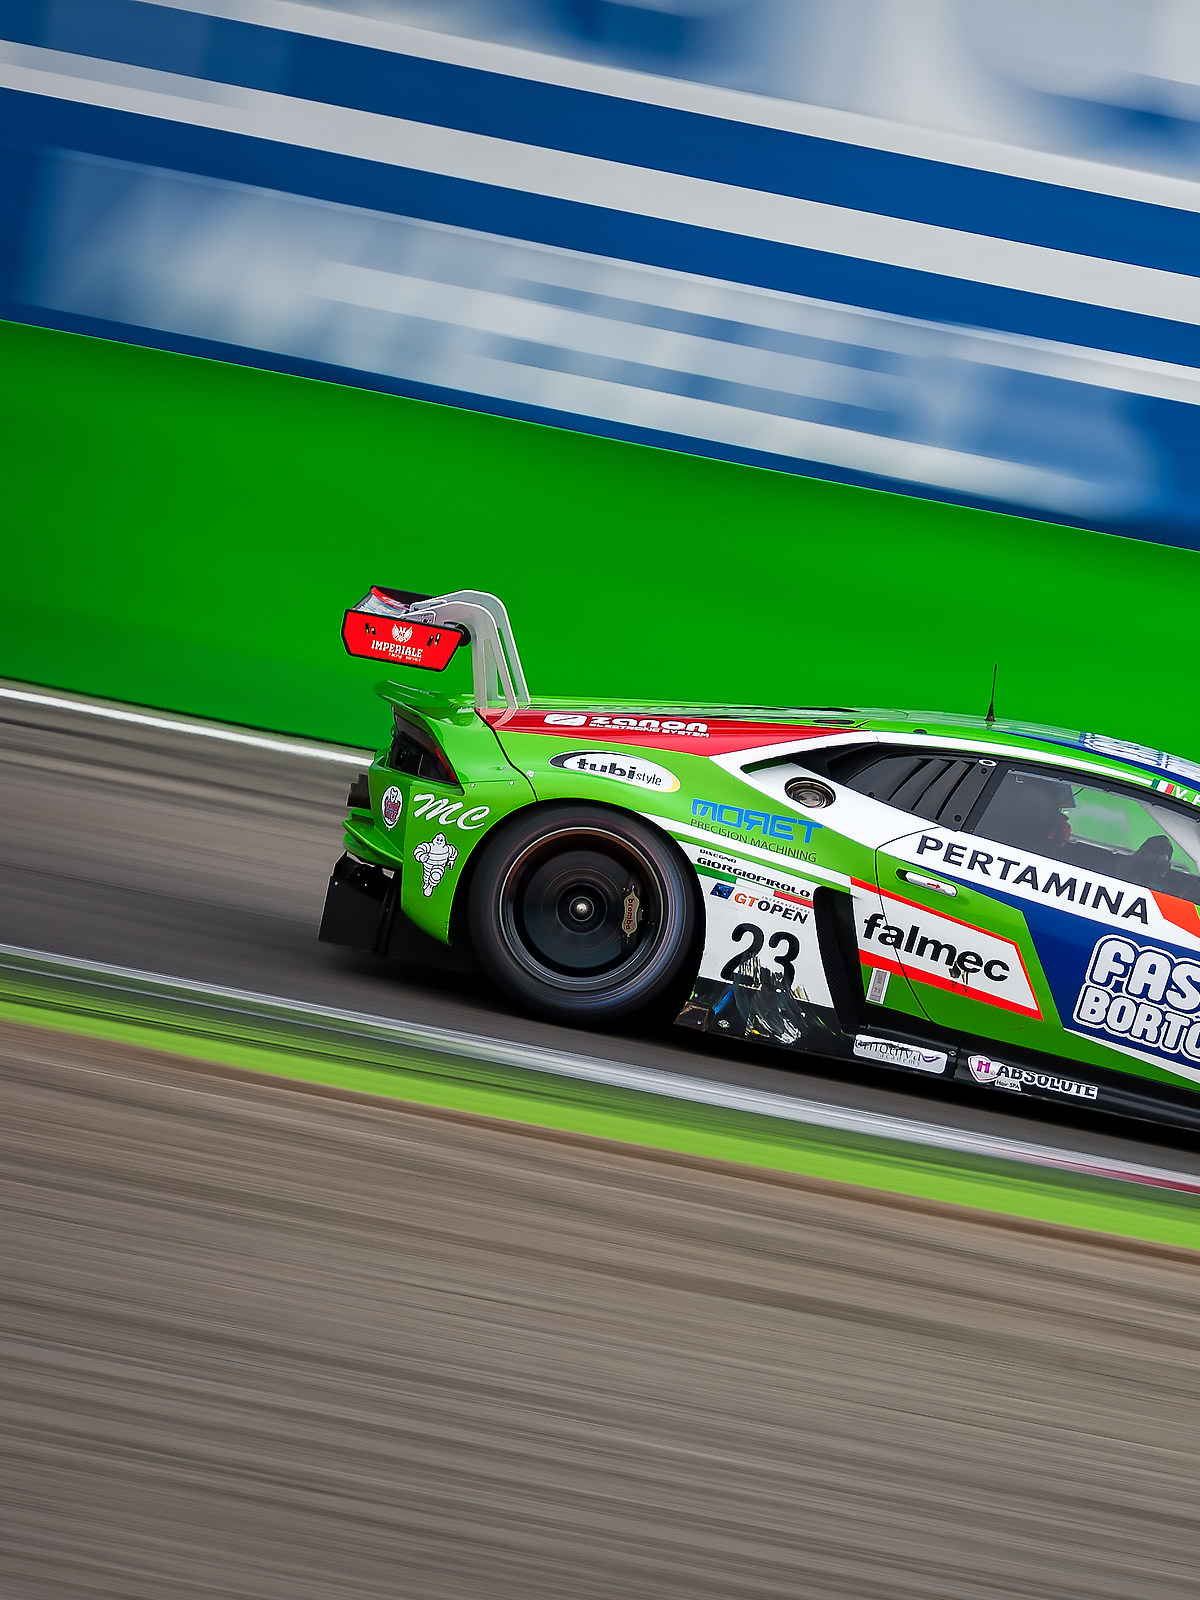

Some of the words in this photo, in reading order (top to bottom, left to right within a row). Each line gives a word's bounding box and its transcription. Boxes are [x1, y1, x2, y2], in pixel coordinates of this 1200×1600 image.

[371, 639, 423, 659] IMPERIALE
[590, 715, 709, 734] zanon
[690, 818, 748, 844] PRECISION
[750, 836, 817, 863] MACHINING
[915, 834, 1149, 926] PERTAMINA
[720, 922, 800, 990] 23
[863, 912, 1010, 982] falmec
[996, 1065, 1098, 1097] ABSOLUTE
